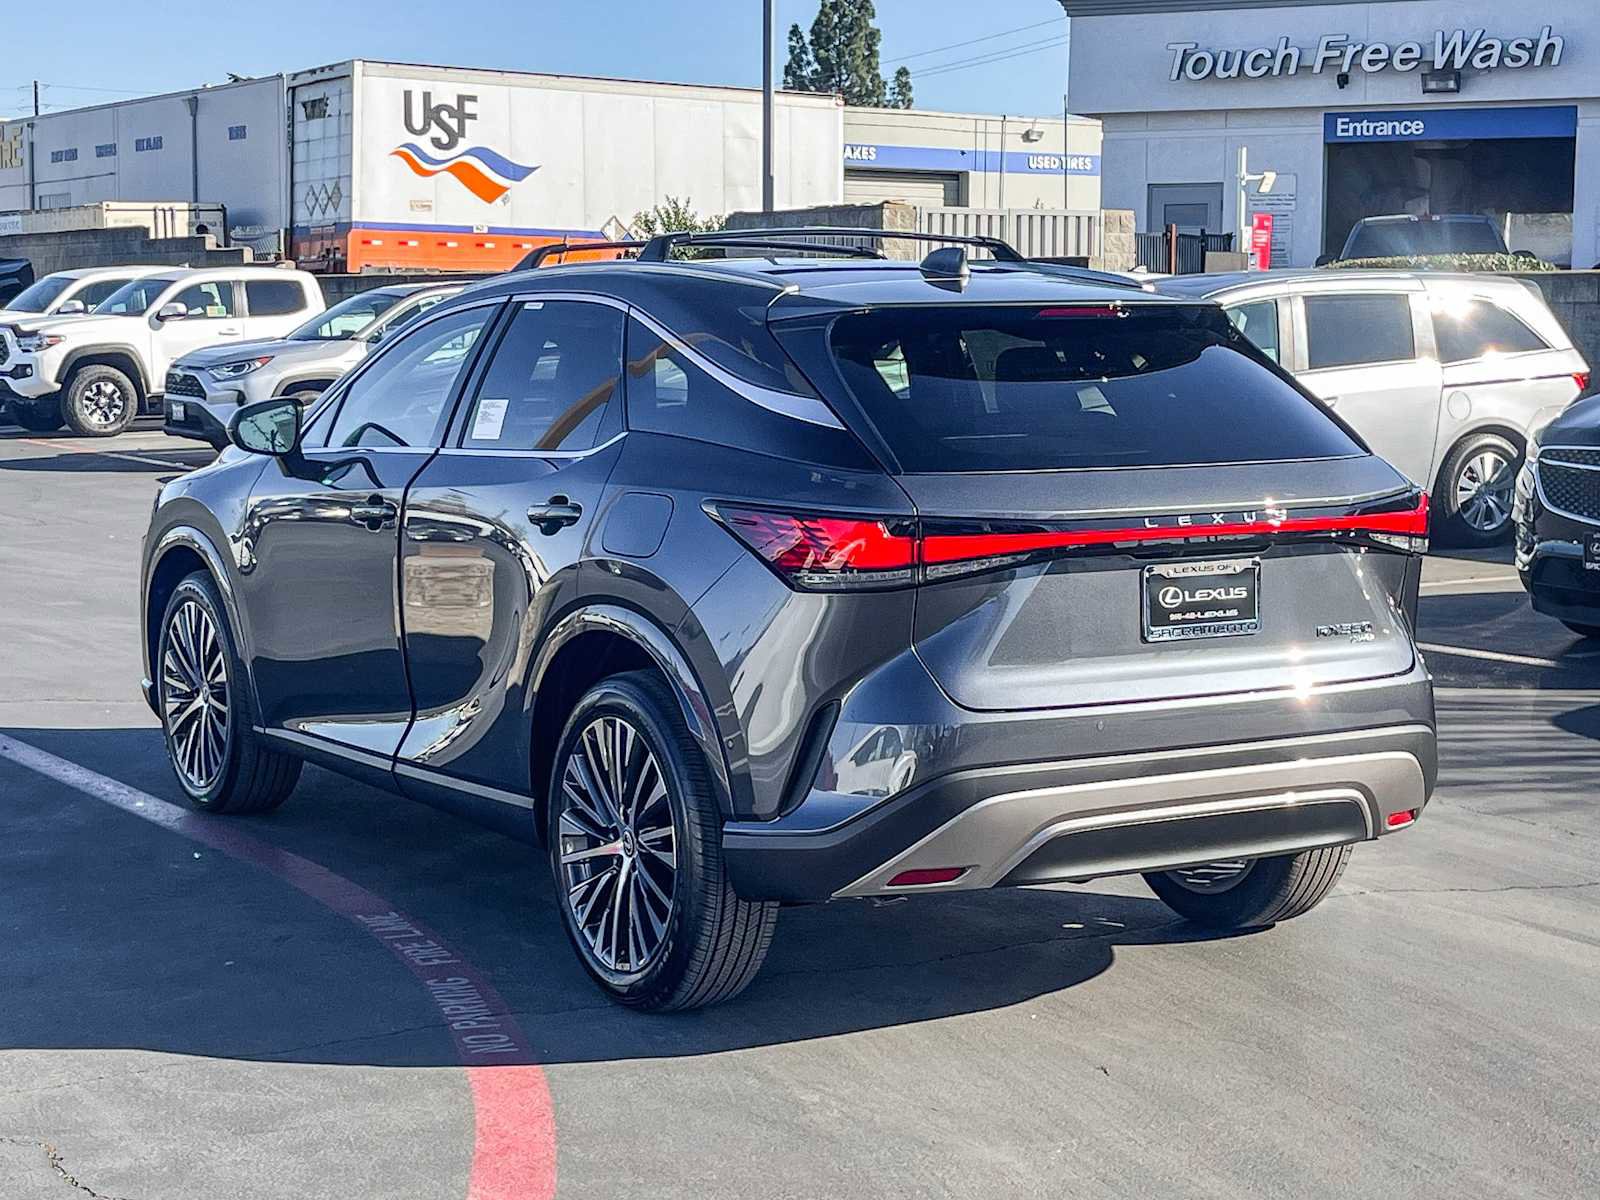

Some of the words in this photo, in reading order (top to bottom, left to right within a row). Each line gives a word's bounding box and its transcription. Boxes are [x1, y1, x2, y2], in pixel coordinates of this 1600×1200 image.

[1167, 37, 1300, 82] Touch
[1312, 34, 1421, 75] Free
[1433, 26, 1565, 70] Wash
[403, 90, 478, 150] USF
[1336, 117, 1424, 137] Entrance
[1028, 155, 1061, 169] USED
[1061, 157, 1093, 170] TIRES
[1144, 509, 1287, 528] LEXUS
[1173, 564, 1215, 574] LEXUS
[1217, 563, 1232, 572] OF
[1184, 587, 1248, 602] LEXUS
[1151, 622, 1258, 639] SACRAMENTO
[356, 911, 424, 940] LANE
[393, 939, 461, 966] FIRE
[426, 977, 501, 1030] PARKING
[462, 1033, 519, 1053] NO
